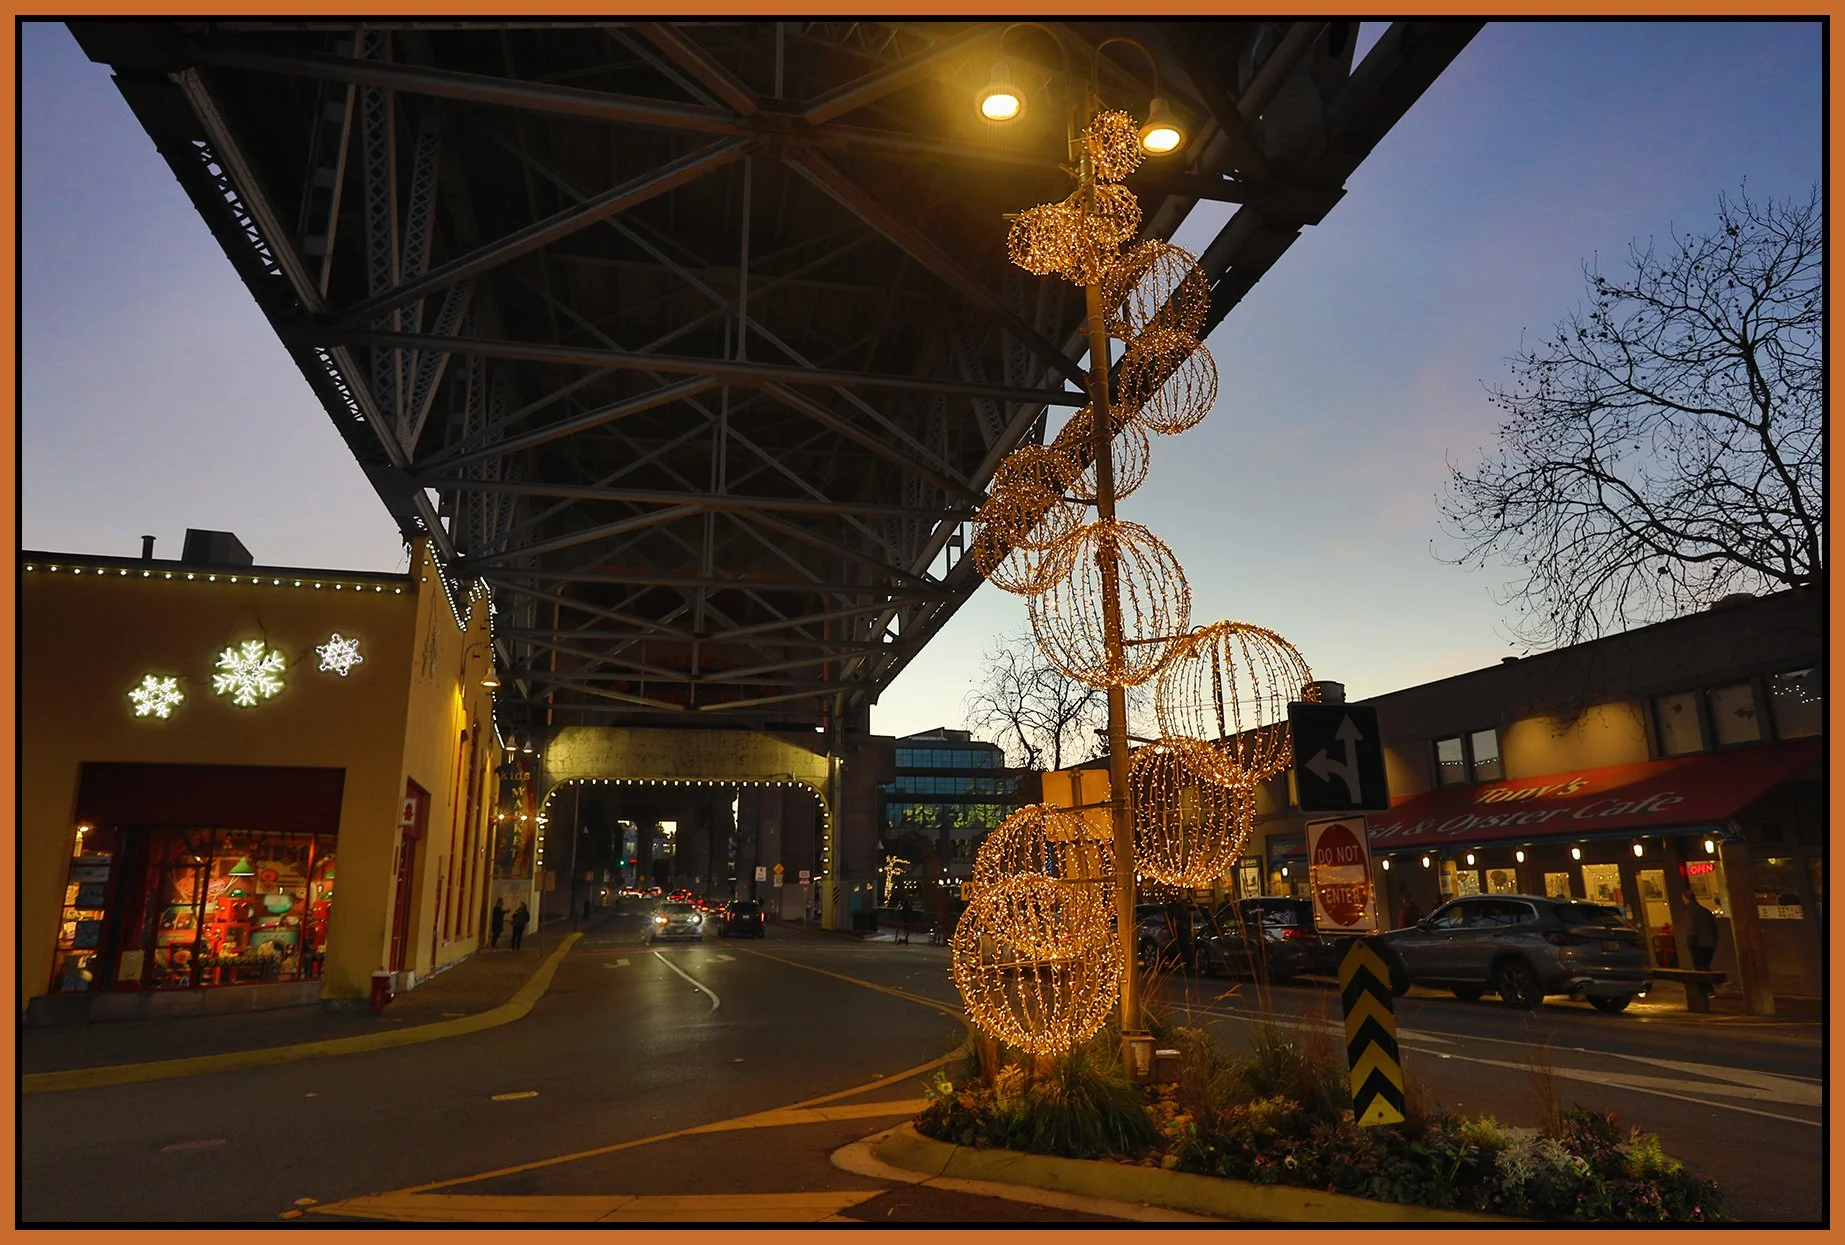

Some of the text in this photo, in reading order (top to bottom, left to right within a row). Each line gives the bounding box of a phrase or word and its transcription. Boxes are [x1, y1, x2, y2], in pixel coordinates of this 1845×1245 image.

[501, 772, 531, 780] kids
[1472, 777, 1590, 804] Tony's
[1401, 818, 1437, 836] &
[1436, 807, 1571, 836] Oyster
[1317, 847, 1334, 864] DO
[1336, 844, 1360, 862] NOT
[1690, 863, 1714, 875] OPEN
[1326, 887, 1361, 904] ENTER
